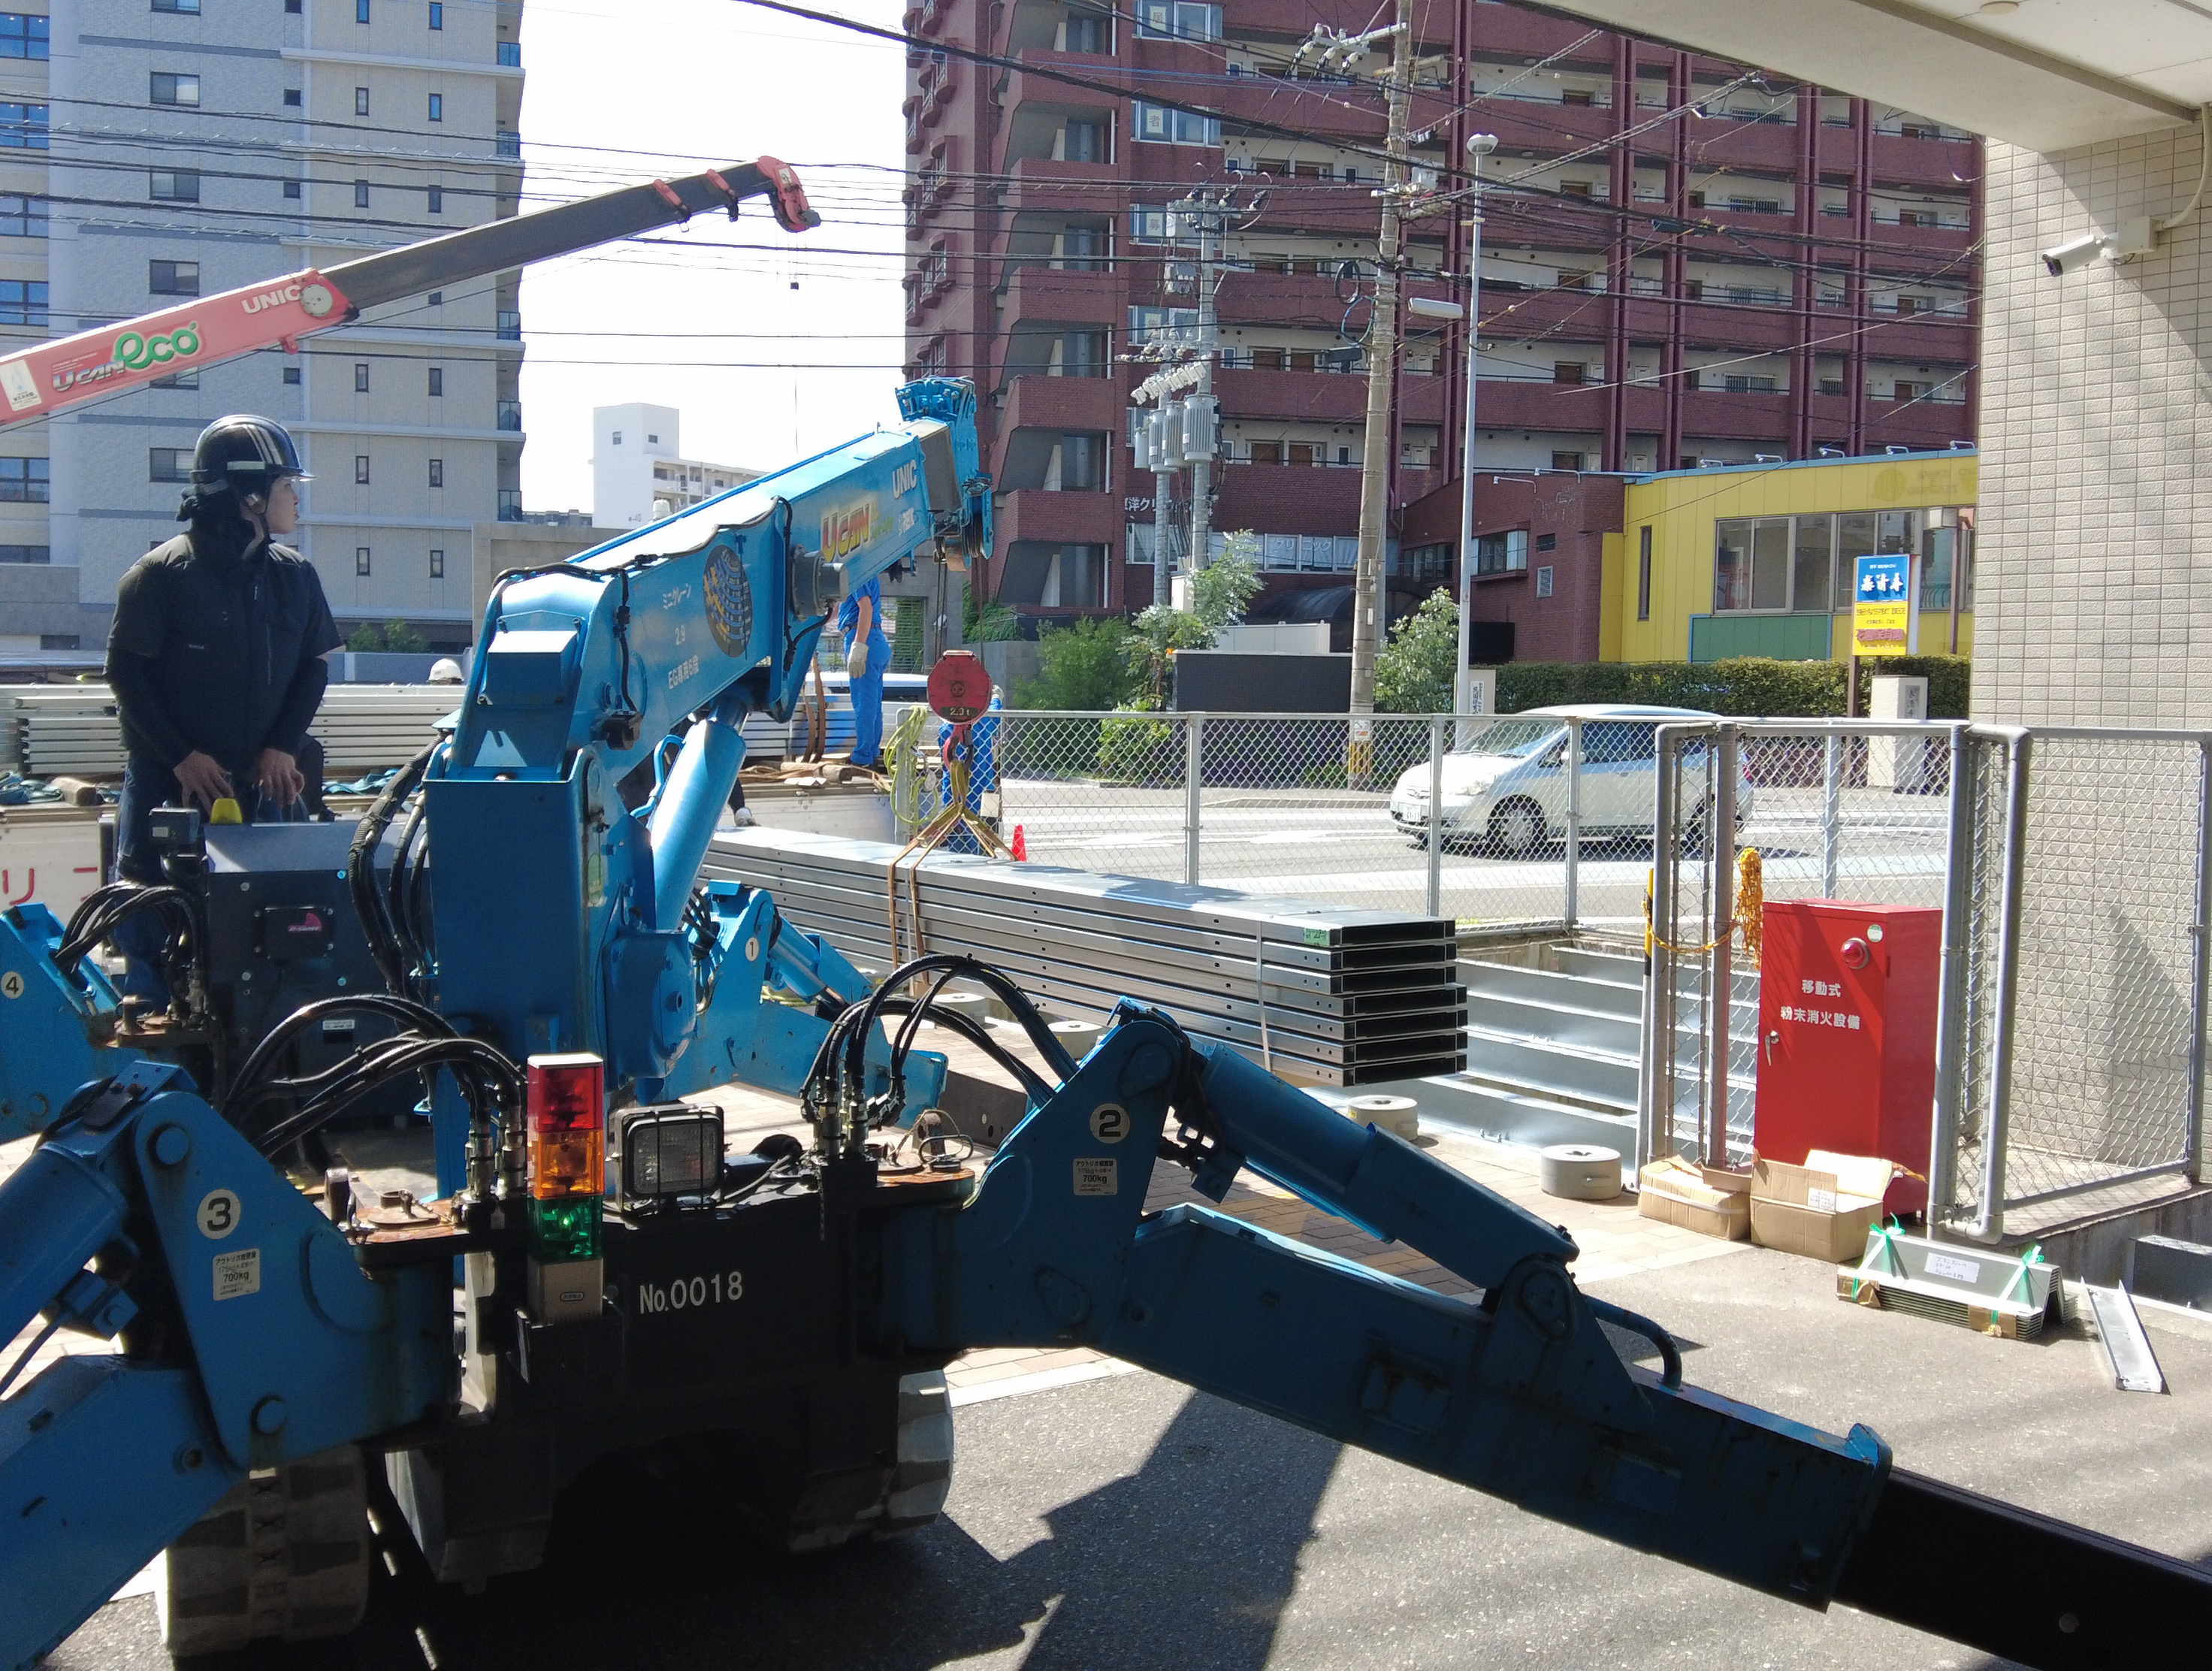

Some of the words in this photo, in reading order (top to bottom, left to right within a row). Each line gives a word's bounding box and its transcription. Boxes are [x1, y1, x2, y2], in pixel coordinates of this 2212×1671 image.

[241, 284, 302, 314] UNIC
[892, 459, 917, 500] UNIC
[1802, 979, 1842, 998] 移動式
[1781, 1005, 1860, 1030] 粉末消火設備
[1098, 1110, 1121, 1138] 2
[1083, 1174, 1107, 1184] 700kg
[207, 1197, 231, 1232] 3
[223, 1271, 249, 1283] 700kg
[639, 1271, 743, 1314] No.0018
